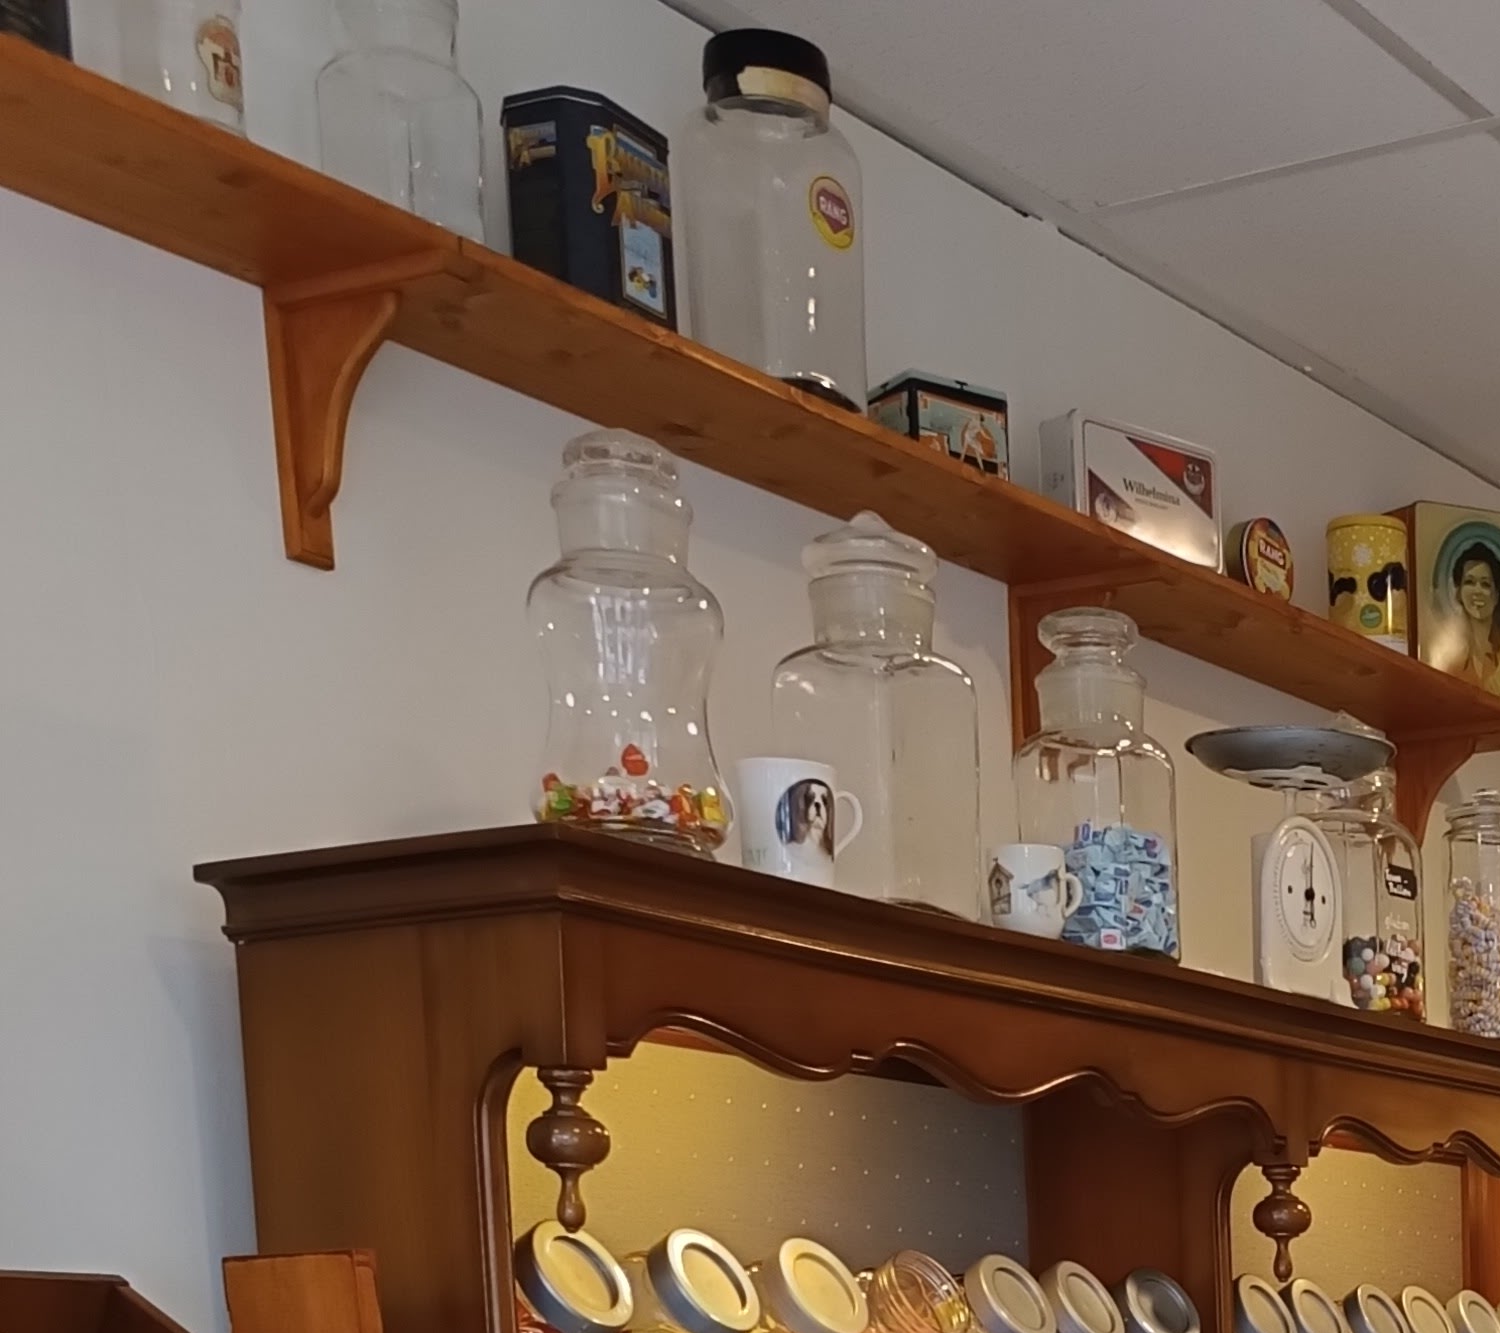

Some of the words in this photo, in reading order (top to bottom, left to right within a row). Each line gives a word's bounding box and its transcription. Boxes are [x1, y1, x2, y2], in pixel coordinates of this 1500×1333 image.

[819, 195, 848, 226] RANG
[1122, 476, 1182, 507] Wilhelmina
[1258, 539, 1286, 568] RANG
